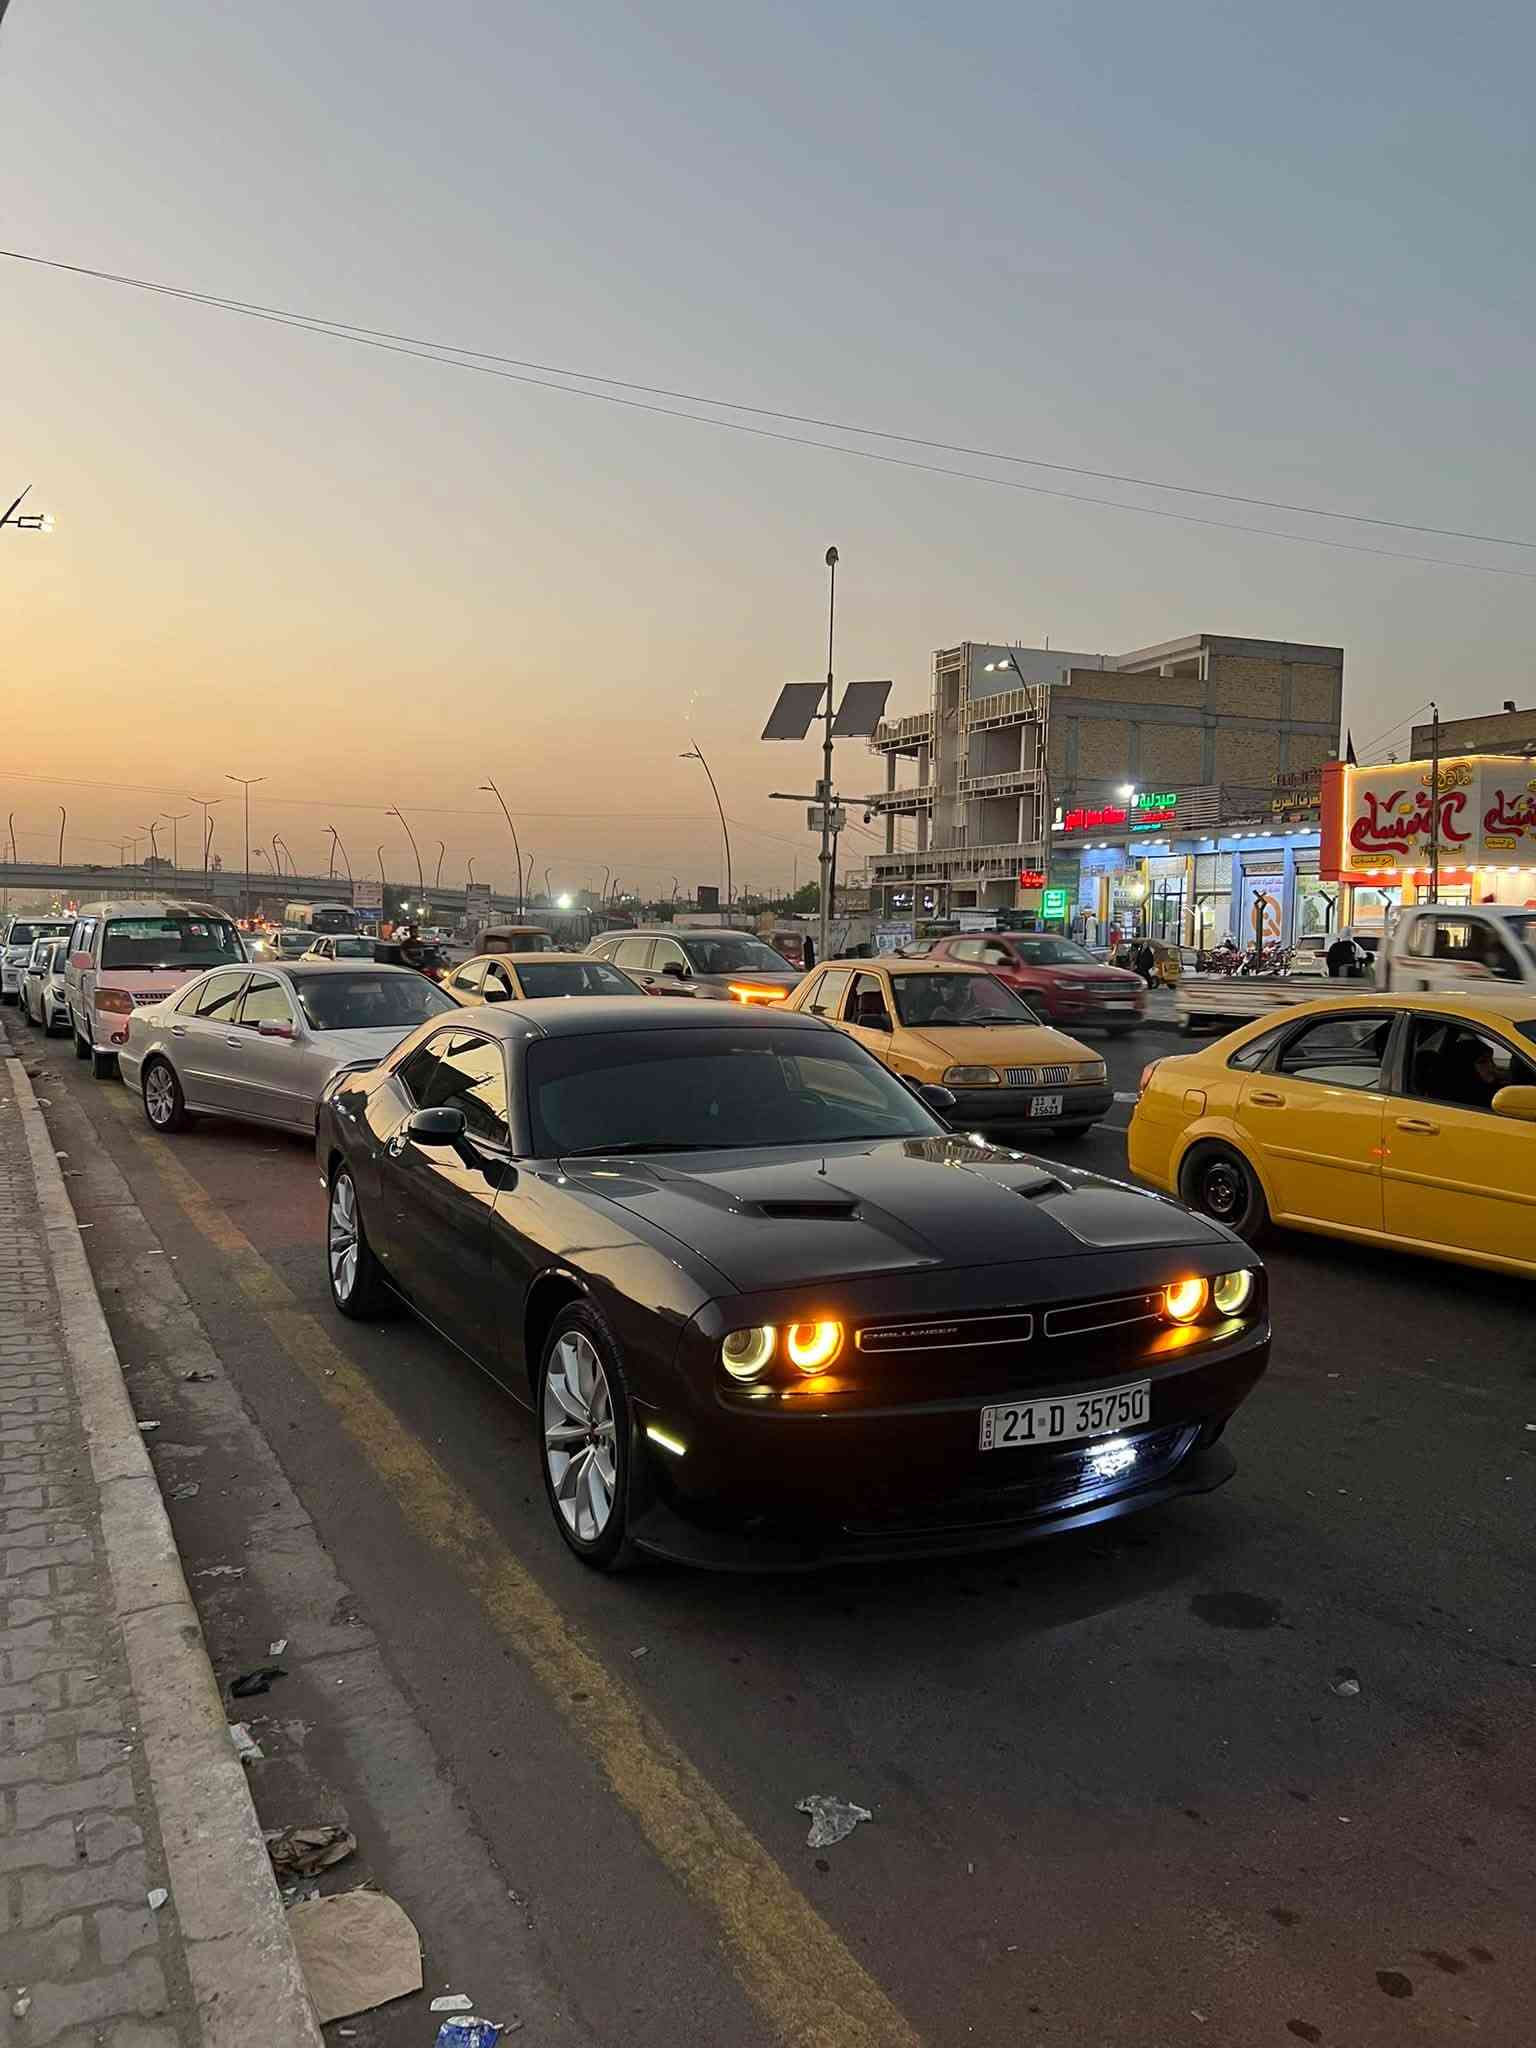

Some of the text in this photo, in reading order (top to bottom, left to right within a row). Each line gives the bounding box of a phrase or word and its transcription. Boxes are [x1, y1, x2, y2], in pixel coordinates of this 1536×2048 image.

[1003, 1388, 1144, 1442] 21 D 35750
